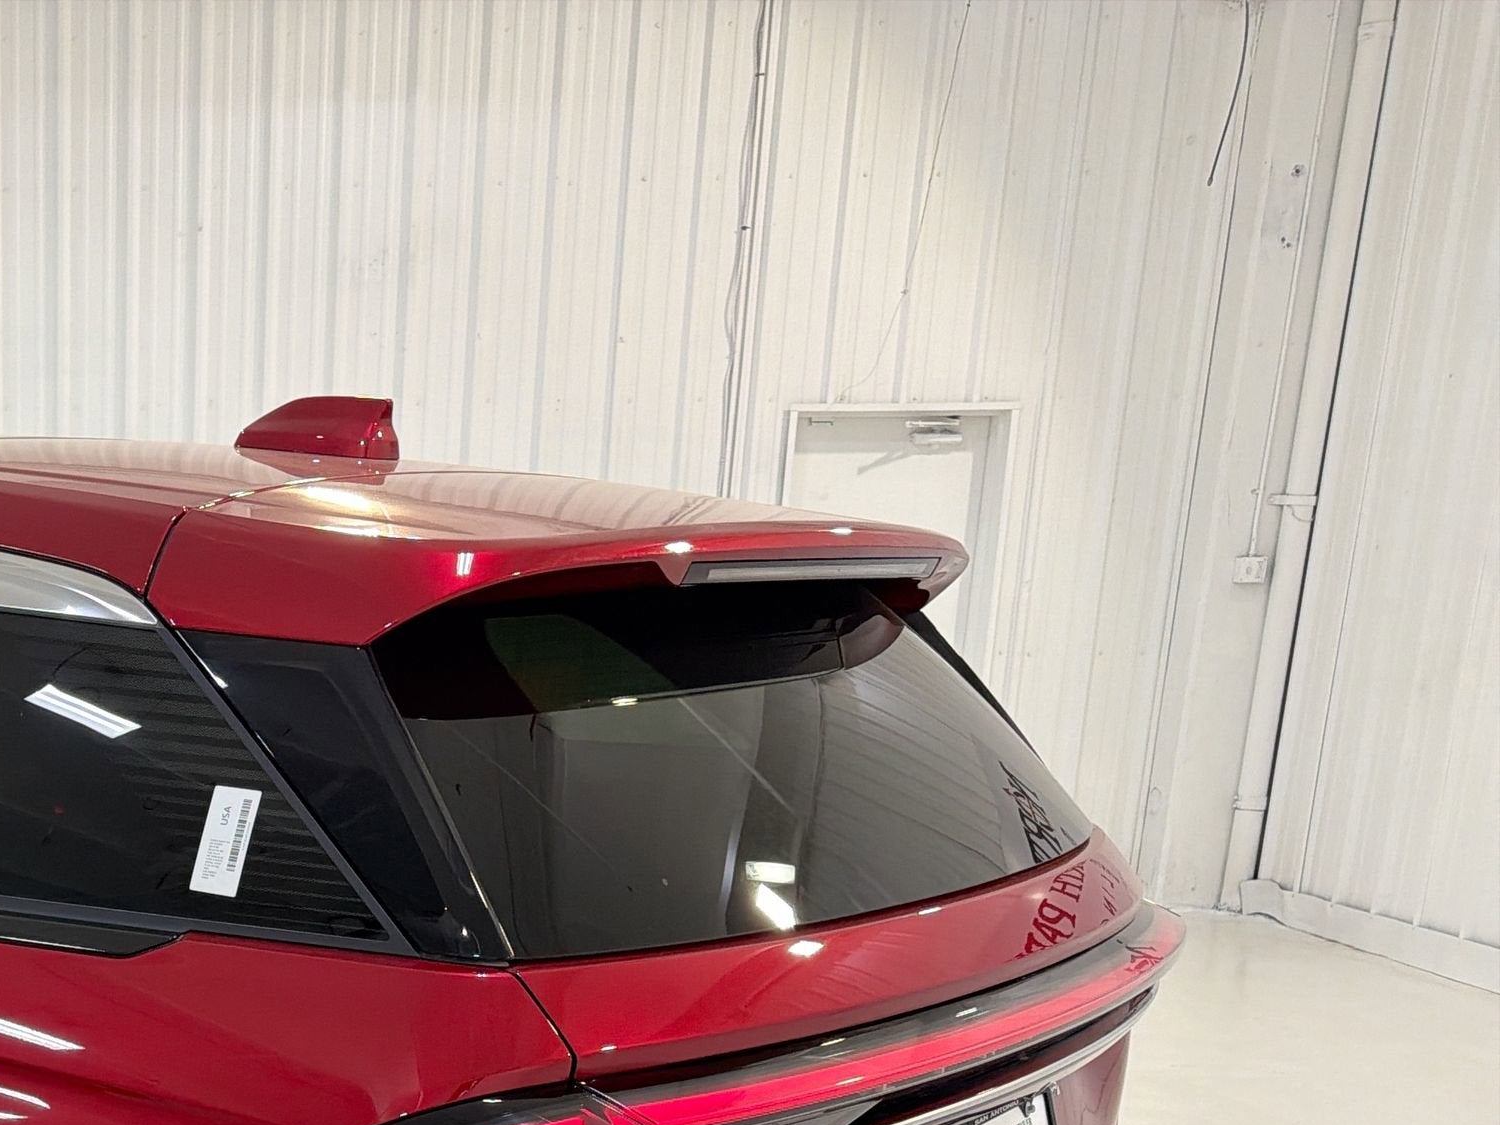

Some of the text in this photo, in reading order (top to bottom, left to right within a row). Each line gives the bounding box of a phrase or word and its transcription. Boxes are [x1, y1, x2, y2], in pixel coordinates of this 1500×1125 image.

[220, 806, 232, 826] USA
[974, 1101, 1019, 1125] SAN ANTONIO
